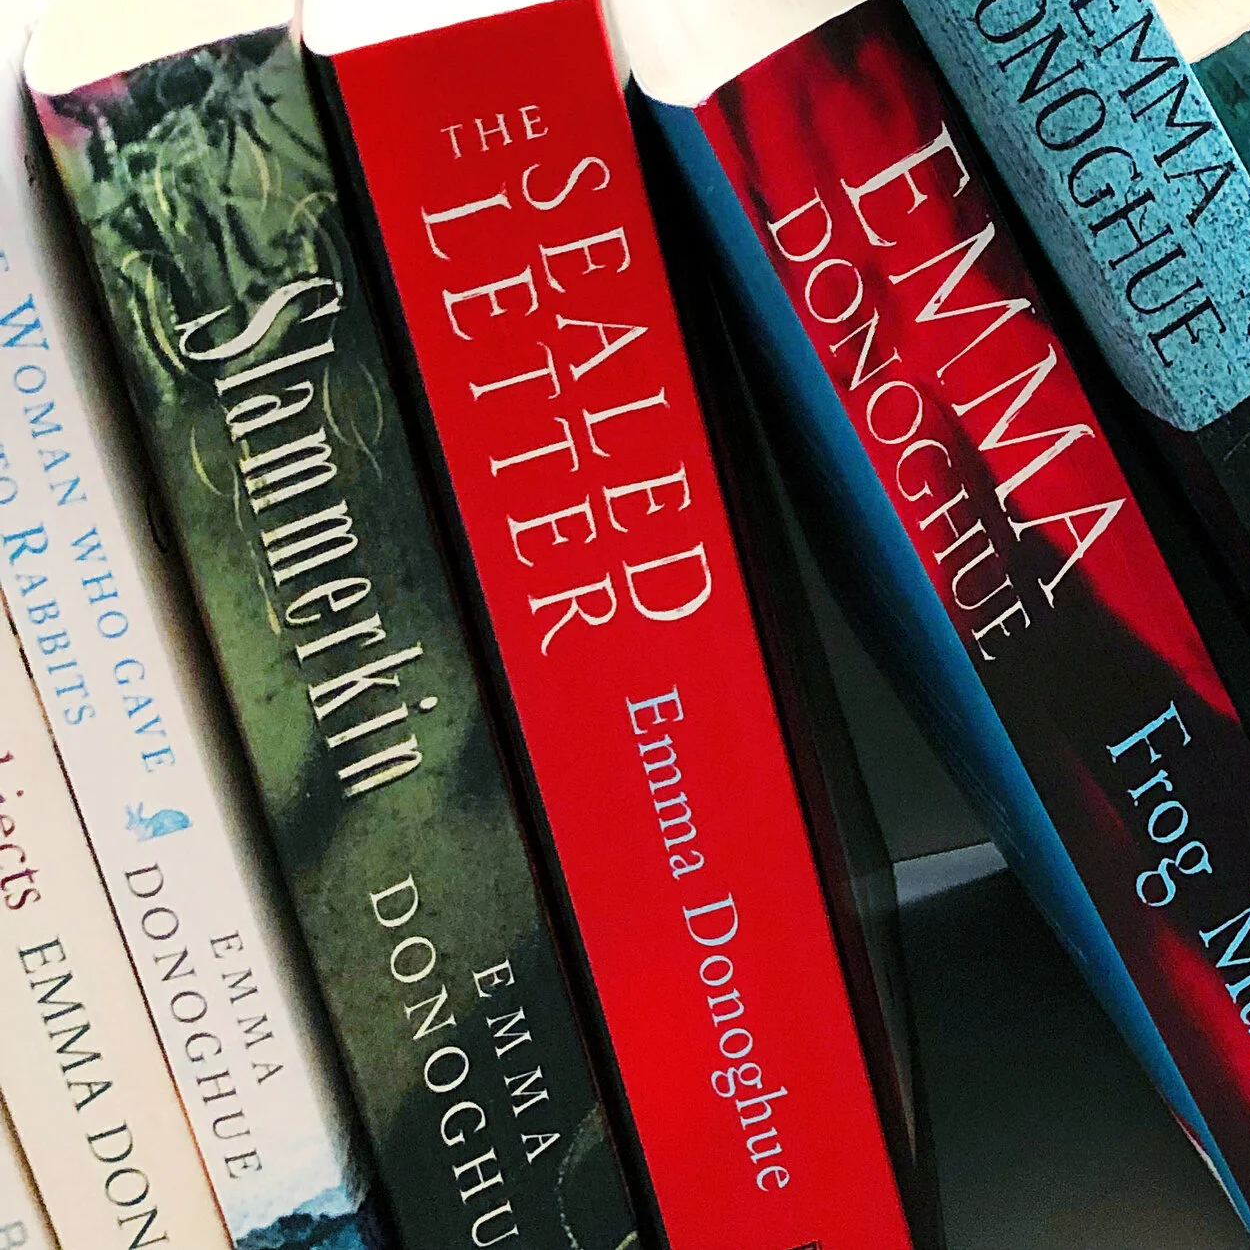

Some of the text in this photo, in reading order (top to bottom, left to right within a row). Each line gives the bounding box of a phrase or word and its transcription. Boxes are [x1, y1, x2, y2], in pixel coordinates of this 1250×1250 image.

[441, 105, 548, 159] THE
[0, 293, 175, 772] WOMAN WHO GAVE
[174, 277, 438, 797] Slammerkin
[421, 182, 618, 656] LETTER
[522, 155, 713, 621] SEALED
[767, 188, 1031, 661] DONOGHUE
[841, 121, 1135, 608] EMMA
[2, 522, 95, 726] RABBITS
[1106, 700, 1212, 907] Frog
[18, 935, 114, 1112] EMMA
[86, 1123, 168, 1250] DON
[124, 863, 261, 1181] DONOGHUE
[210, 931, 284, 1085] EMMA
[370, 874, 519, 1248] DONOGHU
[473, 959, 560, 1164] EMMA
[625, 685, 790, 1193] Emma Donoghue
